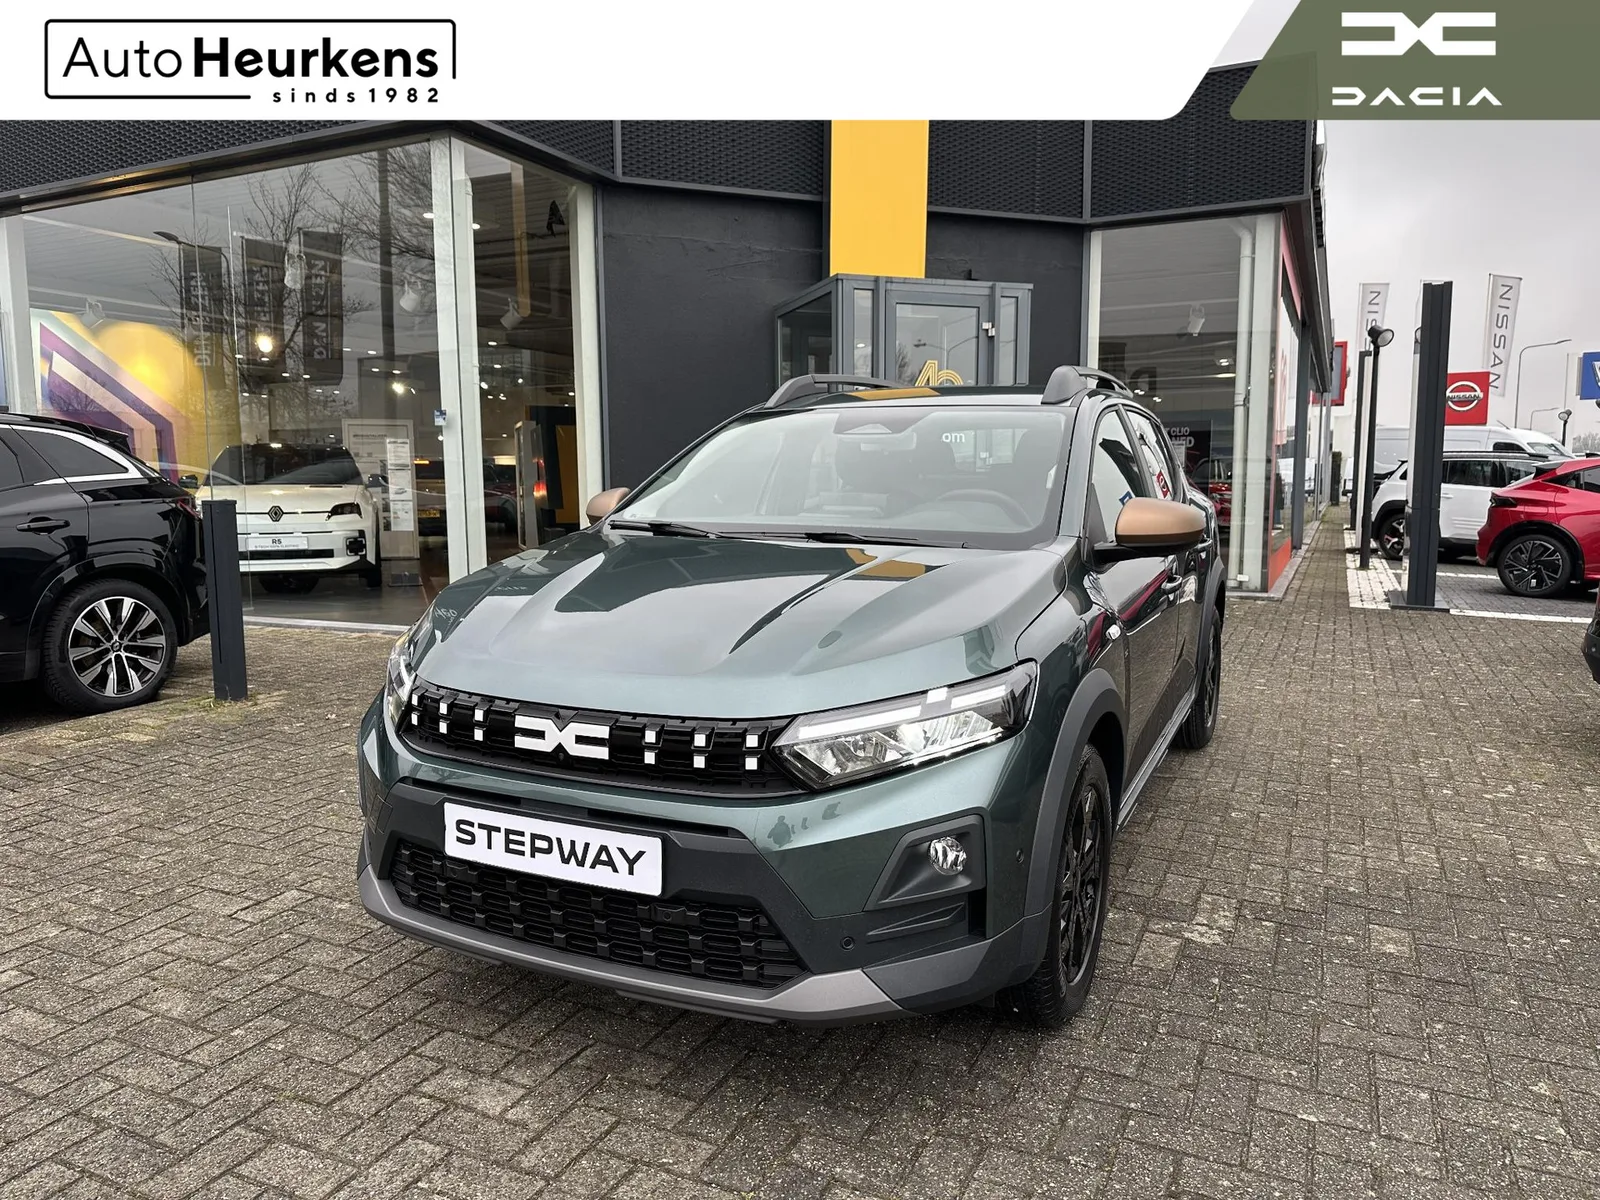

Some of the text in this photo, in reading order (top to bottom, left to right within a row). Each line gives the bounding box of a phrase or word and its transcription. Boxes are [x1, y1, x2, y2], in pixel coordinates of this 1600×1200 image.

[1488, 283, 1513, 389] NISSAN
[1170, 427, 1190, 436] CLIO
[455, 818, 647, 876] STEPWAY
